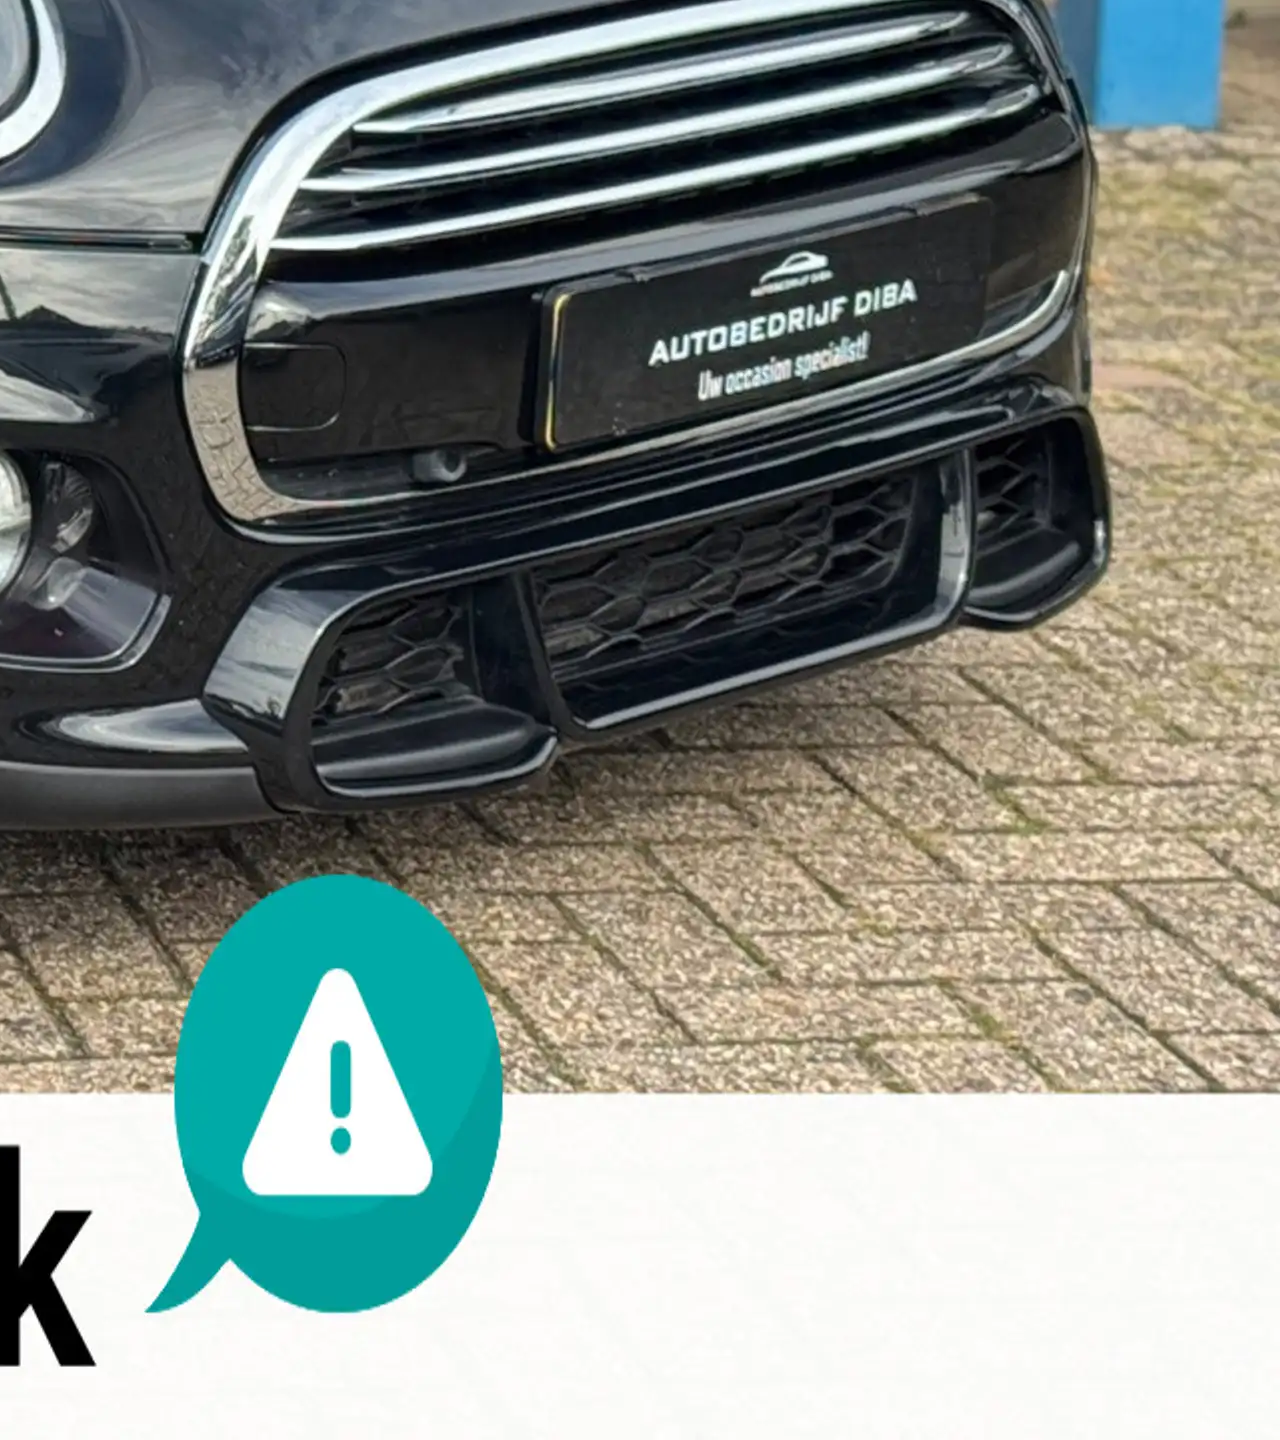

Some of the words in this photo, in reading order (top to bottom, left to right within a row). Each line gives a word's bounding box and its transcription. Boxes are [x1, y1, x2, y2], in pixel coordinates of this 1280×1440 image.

[648, 296, 848, 367] AUTOBEDRIJF
[854, 278, 918, 317] DIBA
[698, 369, 723, 401] Uw
[726, 356, 792, 395] occasion
[794, 330, 871, 381] specialist!
